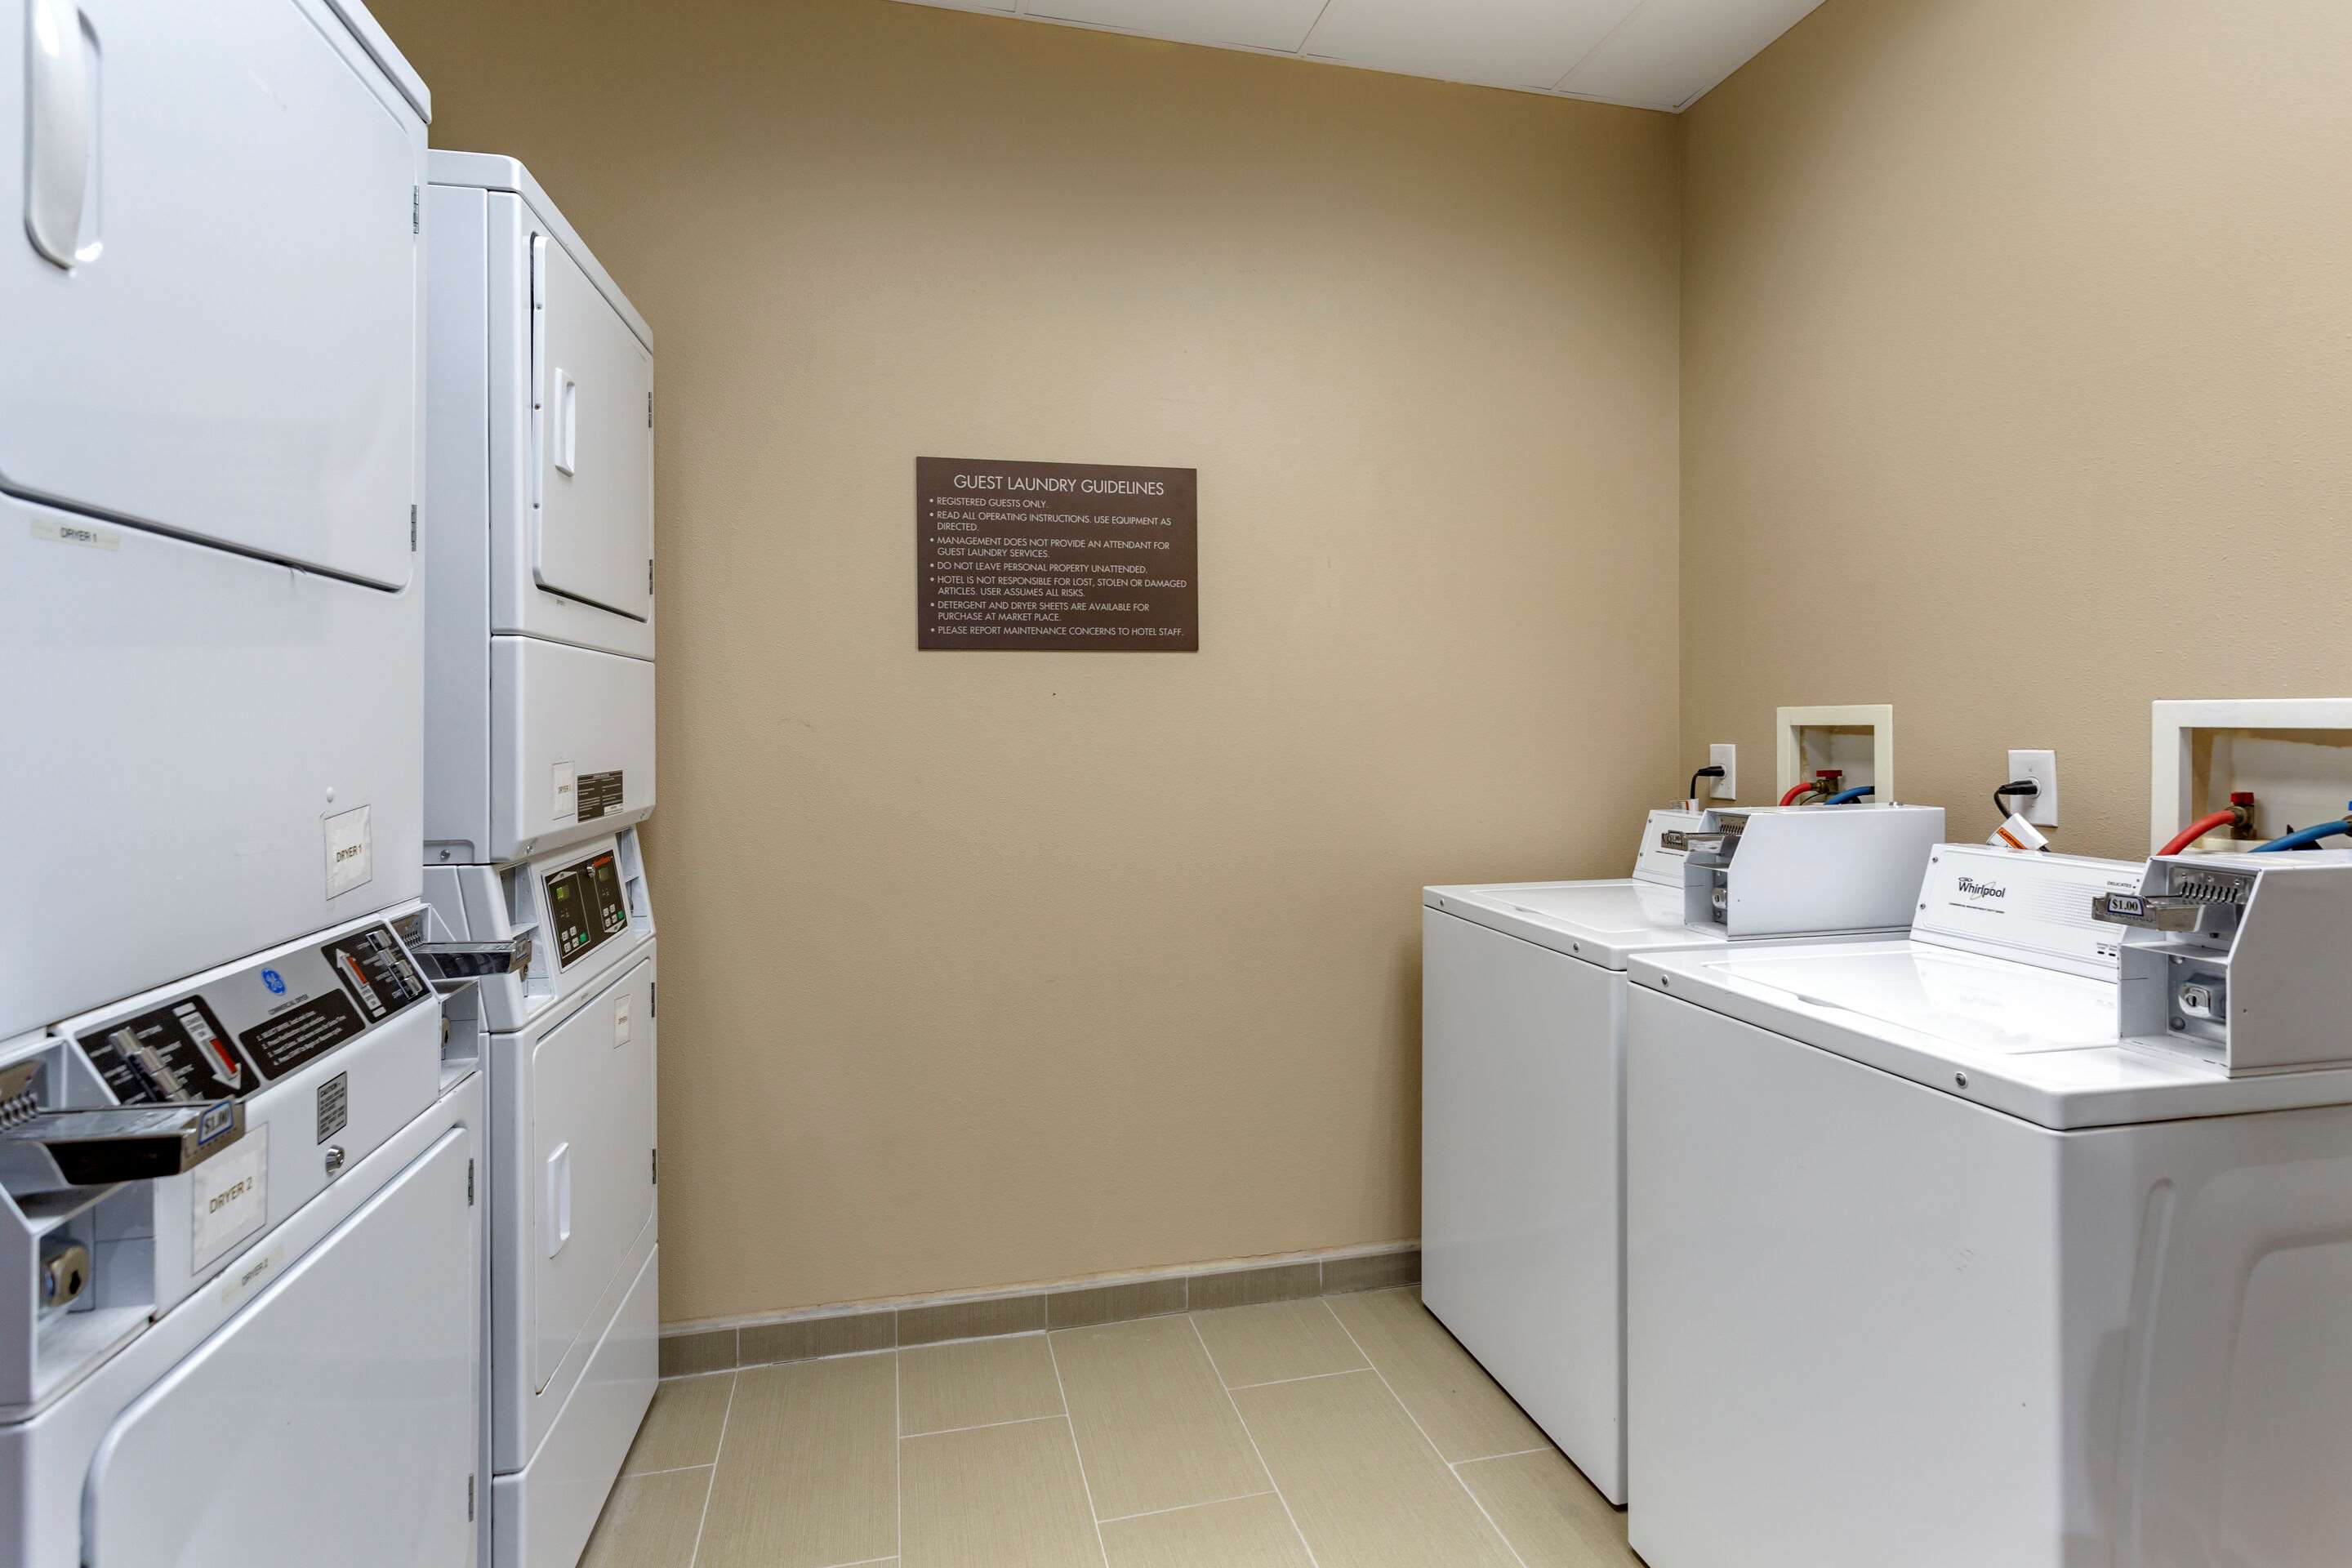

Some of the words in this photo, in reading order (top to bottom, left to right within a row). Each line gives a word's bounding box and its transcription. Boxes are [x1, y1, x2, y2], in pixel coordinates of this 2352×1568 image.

[953, 474, 1003, 489] GUEST
[1008, 476, 1076, 492] LAUNDRY
[1080, 479, 1164, 496] GUIDELINES
[937, 497, 987, 506] REGISTERED
[988, 498, 1021, 507] GUESTS
[1022, 499, 1048, 508] ONLY.
[937, 510, 960, 519] READ
[961, 510, 976, 519] ALL
[978, 511, 1027, 521] OPERATING
[1029, 513, 1091, 523] INSTRUCTIONS.
[1094, 515, 1109, 523] USE
[1111, 515, 1159, 525] EQUIPMENT
[1160, 517, 1171, 525] AS
[937, 522, 979, 531] DIRECTED.
[60, 527, 91, 542] DRYER
[937, 535, 1001, 546] MANAGEMENT
[1003, 537, 1027, 546] DOES
[1029, 538, 1048, 546] NOT
[1050, 538, 1085, 547] PROVIDE
[1087, 540, 1101, 548] AN
[1102, 540, 1152, 549] ATTENDANT
[1153, 541, 1169, 550] FOR
[937, 547, 965, 555] GUEST
[967, 547, 1007, 557] LAUNDRY
[1009, 549, 1049, 558] SERVICES.
[937, 561, 951, 569] DO
[953, 561, 973, 570] NOT
[975, 562, 1001, 570] LEAVE
[1003, 562, 1048, 571] PERSONAL
[1049, 564, 1089, 572] PROPERTY
[1091, 564, 1147, 573] UNATTENDED.
[937, 575, 964, 583] HOTEL
[966, 576, 974, 584] IS
[976, 576, 996, 584] NOT
[997, 576, 1051, 585] RESPONSIBLE
[1054, 577, 1070, 586] FOR
[1072, 577, 1094, 586] LOST,
[1097, 578, 1128, 586] STOLEN
[1144, 579, 1187, 587] DAMAGED
[938, 586, 978, 595] ARTICLES.
[980, 587, 1001, 595] USER
[1003, 587, 1044, 596] ASSUMES
[1045, 588, 1059, 596] ALL
[1061, 589, 1085, 597] RISKS.
[938, 600, 987, 609] DETERGENT
[988, 601, 1009, 609] AND
[1010, 601, 1036, 610] DRYER
[1039, 602, 1068, 610] SHEETS
[1070, 602, 1087, 611] ARE
[1088, 603, 1130, 611] AVAILABLE
[1133, 603, 1149, 612] FOR
[938, 612, 982, 620] PURCHASE
[984, 612, 996, 621] AT
[998, 612, 1031, 621] MARKET
[1034, 613, 1061, 621] PLACE.
[938, 626, 967, 634] PLEASE
[969, 626, 1001, 635] REPORT
[1003, 626, 1067, 635] MAINTENANCE
[1068, 627, 1116, 635] CONCERNS
[1158, 628, 1183, 636] STAFF.
[336, 845, 358, 863] DRYER
[1958, 881, 2006, 898] Whirlpool
[2111, 898, 2139, 911] $1.00
[208, 1181, 245, 1215] DRYER
[246, 1176, 253, 1191] 2
